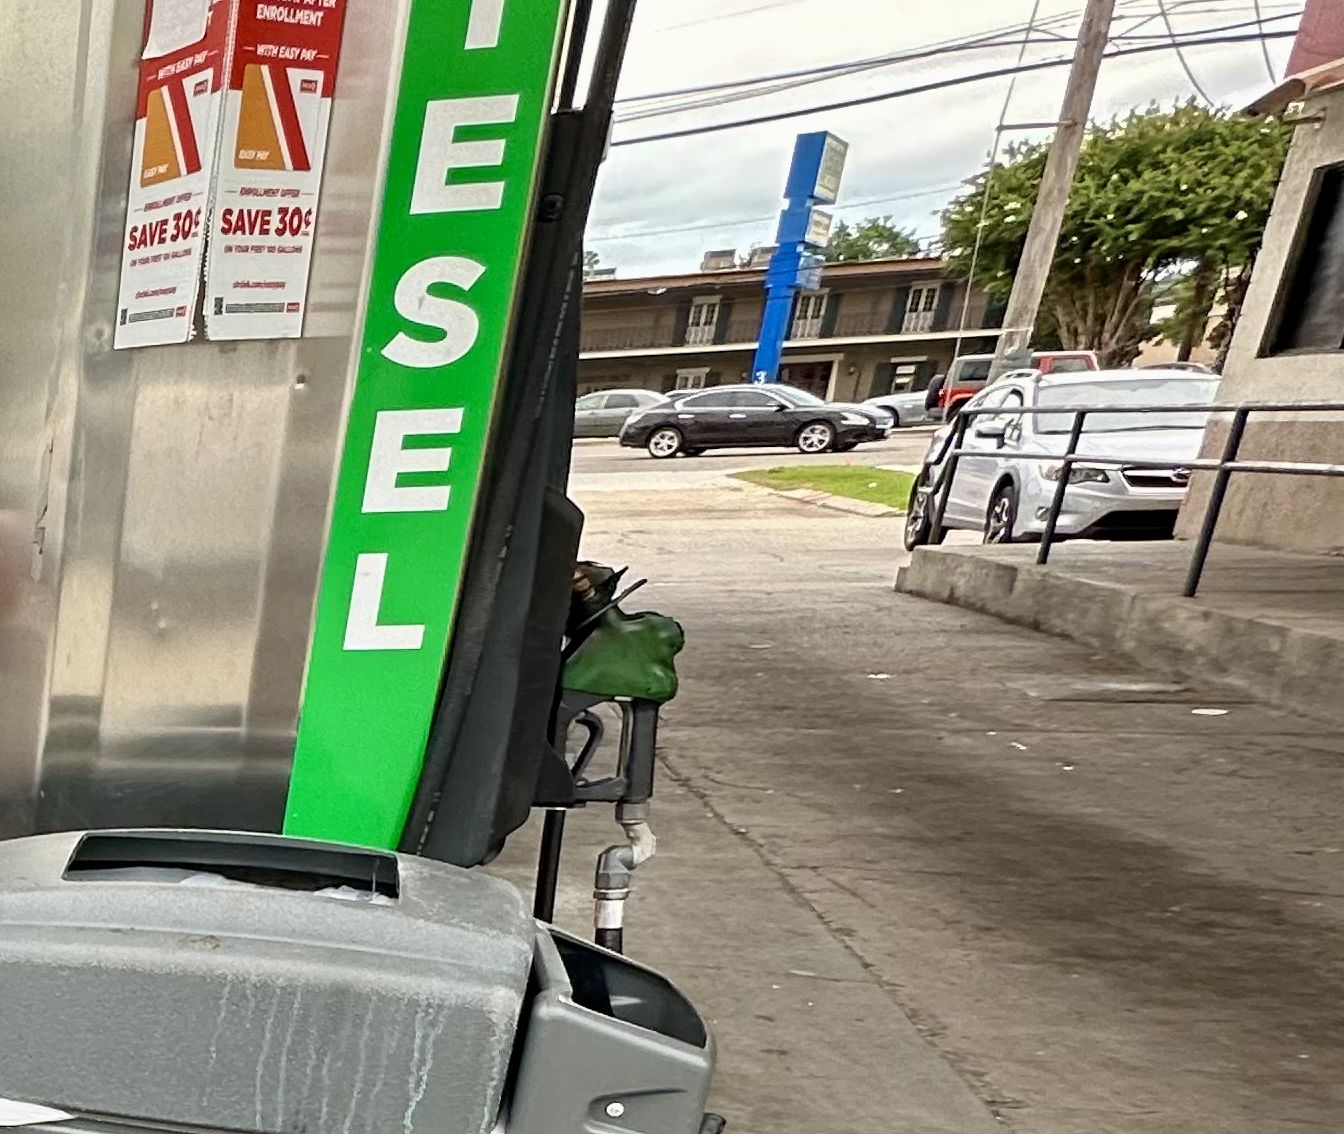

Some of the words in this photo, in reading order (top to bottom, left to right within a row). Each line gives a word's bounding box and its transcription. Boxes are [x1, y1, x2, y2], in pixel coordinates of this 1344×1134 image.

[256, 3, 324, 26] ENROLLMENT
[278, 46, 300, 59] EASY
[300, 48, 318, 61] PAY
[127, 217, 169, 251] SAVE
[170, 207, 202, 243] 30¢
[220, 207, 272, 236] SAVE
[274, 206, 313, 237] 30¢
